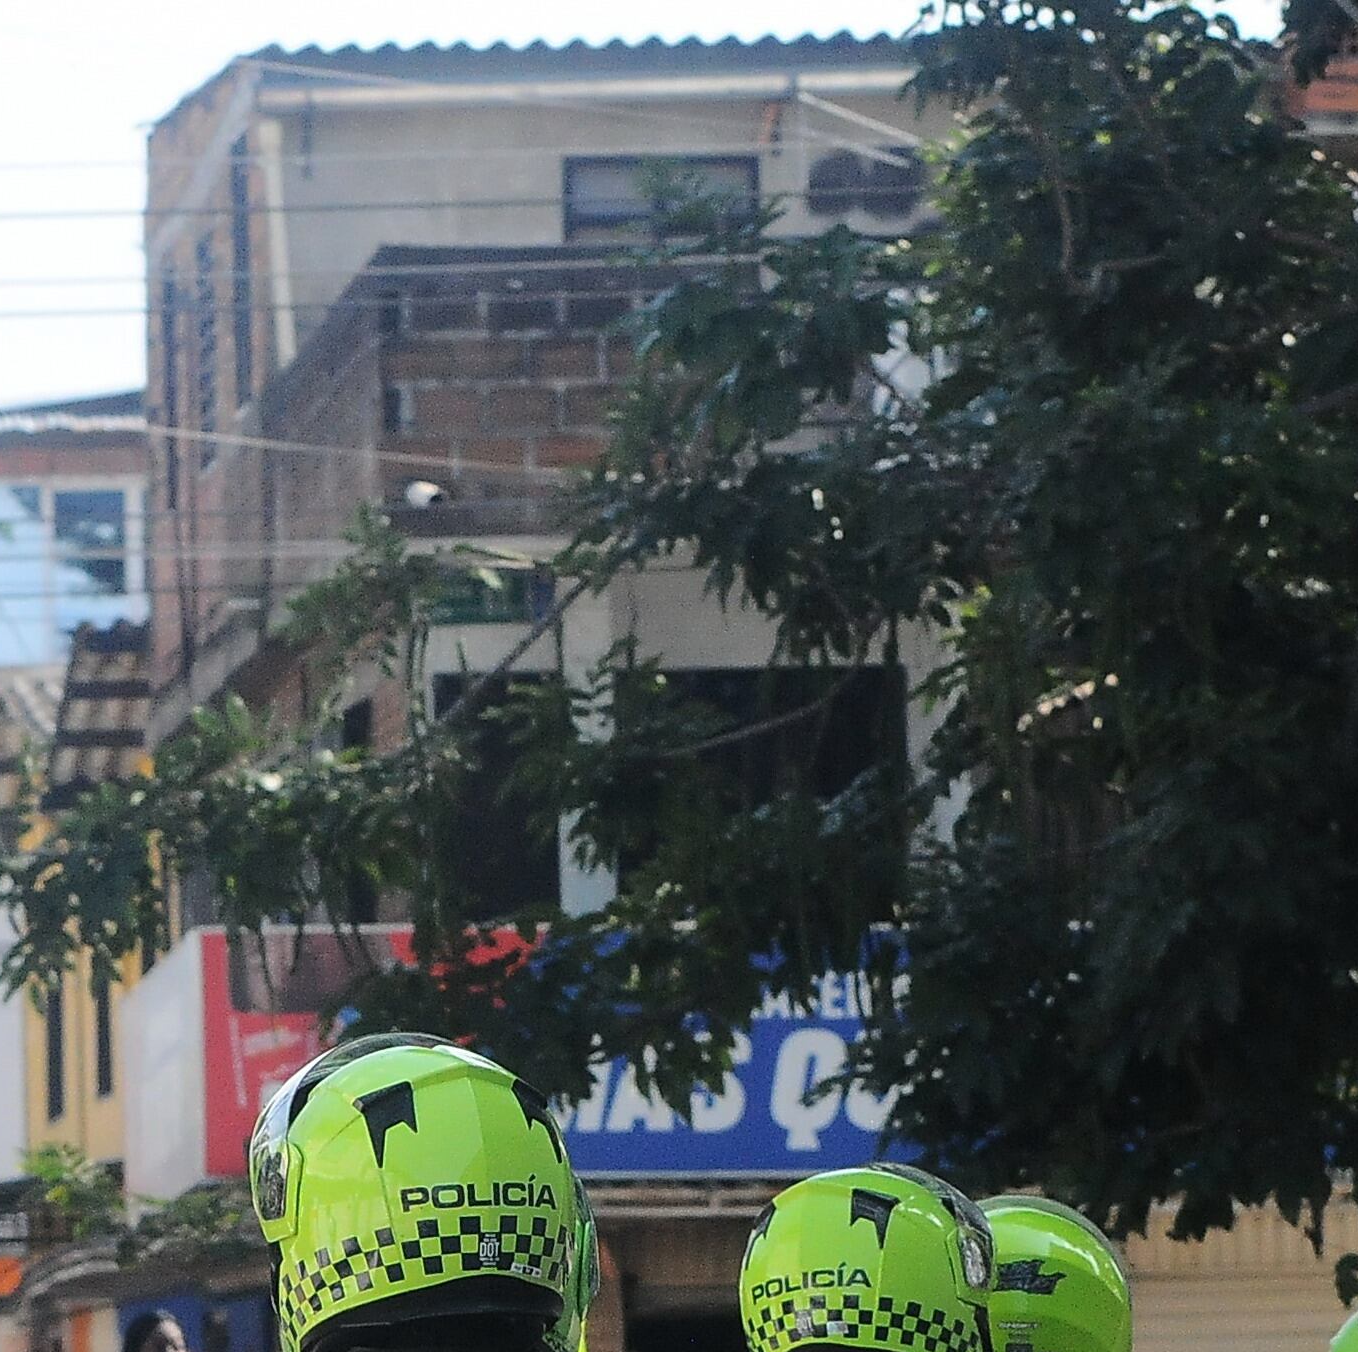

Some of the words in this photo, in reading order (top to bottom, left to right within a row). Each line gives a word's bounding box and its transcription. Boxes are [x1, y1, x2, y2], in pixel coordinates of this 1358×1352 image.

[400, 1173, 557, 1213] POLICÍA
[479, 1241, 500, 1257] DOT
[751, 1261, 872, 1306] POLICÍA
